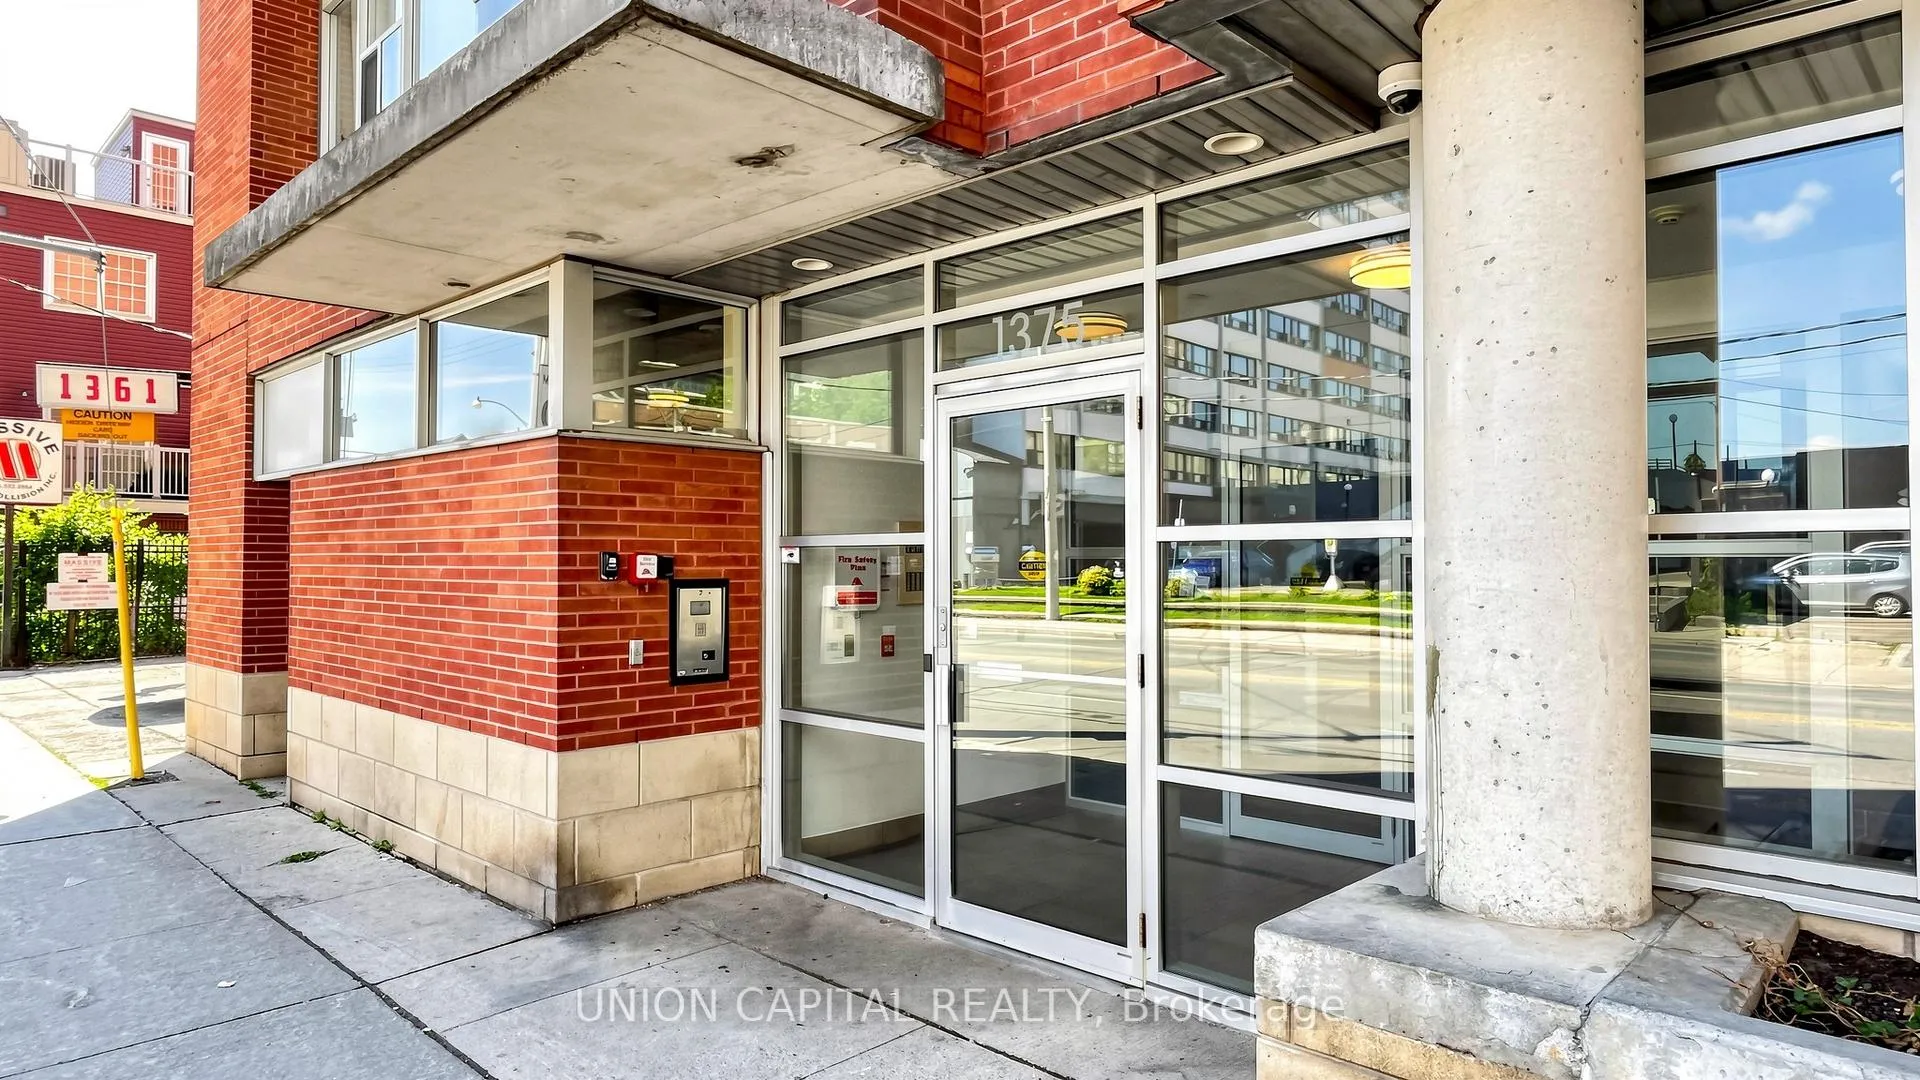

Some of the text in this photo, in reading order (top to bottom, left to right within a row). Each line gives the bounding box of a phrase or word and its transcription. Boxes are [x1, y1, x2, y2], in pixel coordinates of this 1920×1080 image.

[992, 300, 1084, 358] 1375
[60, 373, 156, 404] 1361
[73, 409, 132, 420] CAUTION
